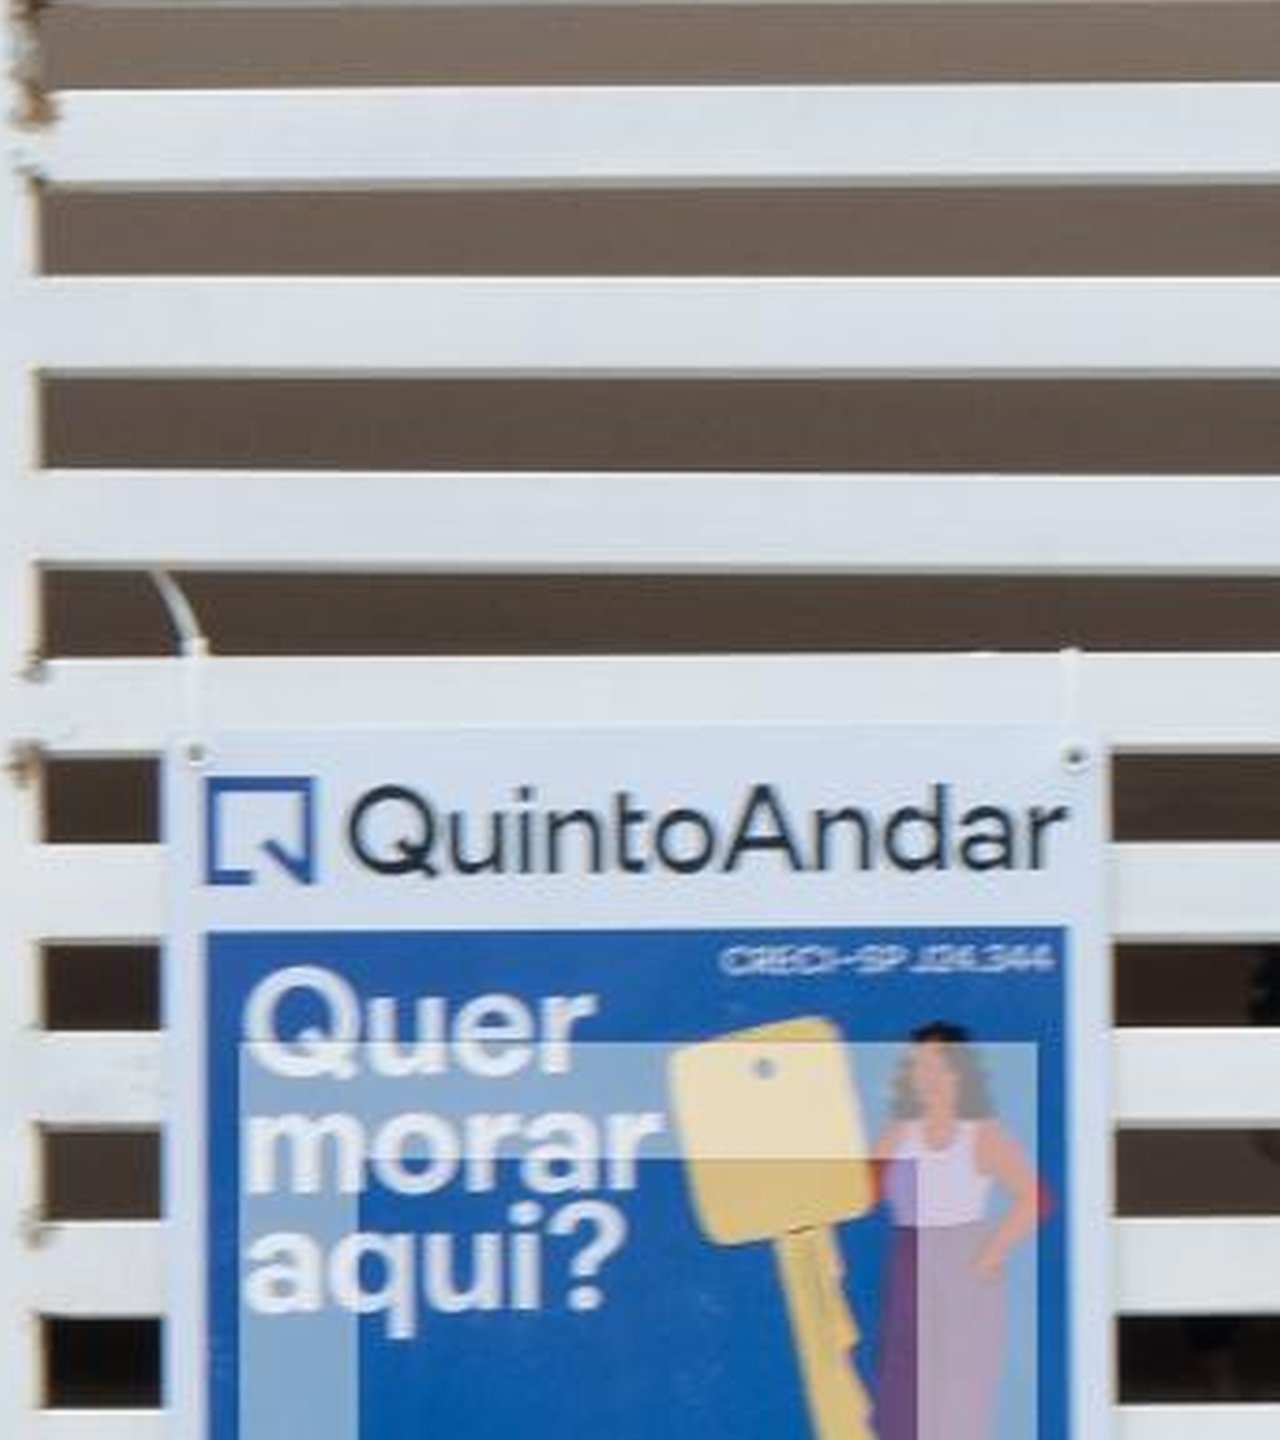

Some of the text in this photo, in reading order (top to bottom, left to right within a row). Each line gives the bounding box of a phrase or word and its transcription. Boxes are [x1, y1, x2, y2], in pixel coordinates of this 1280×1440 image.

[345, 781, 1069, 879] QuintoAndar
[242, 964, 600, 1081] Quer
[242, 1105, 666, 1197] morar
[244, 1200, 627, 1340] aqui?
